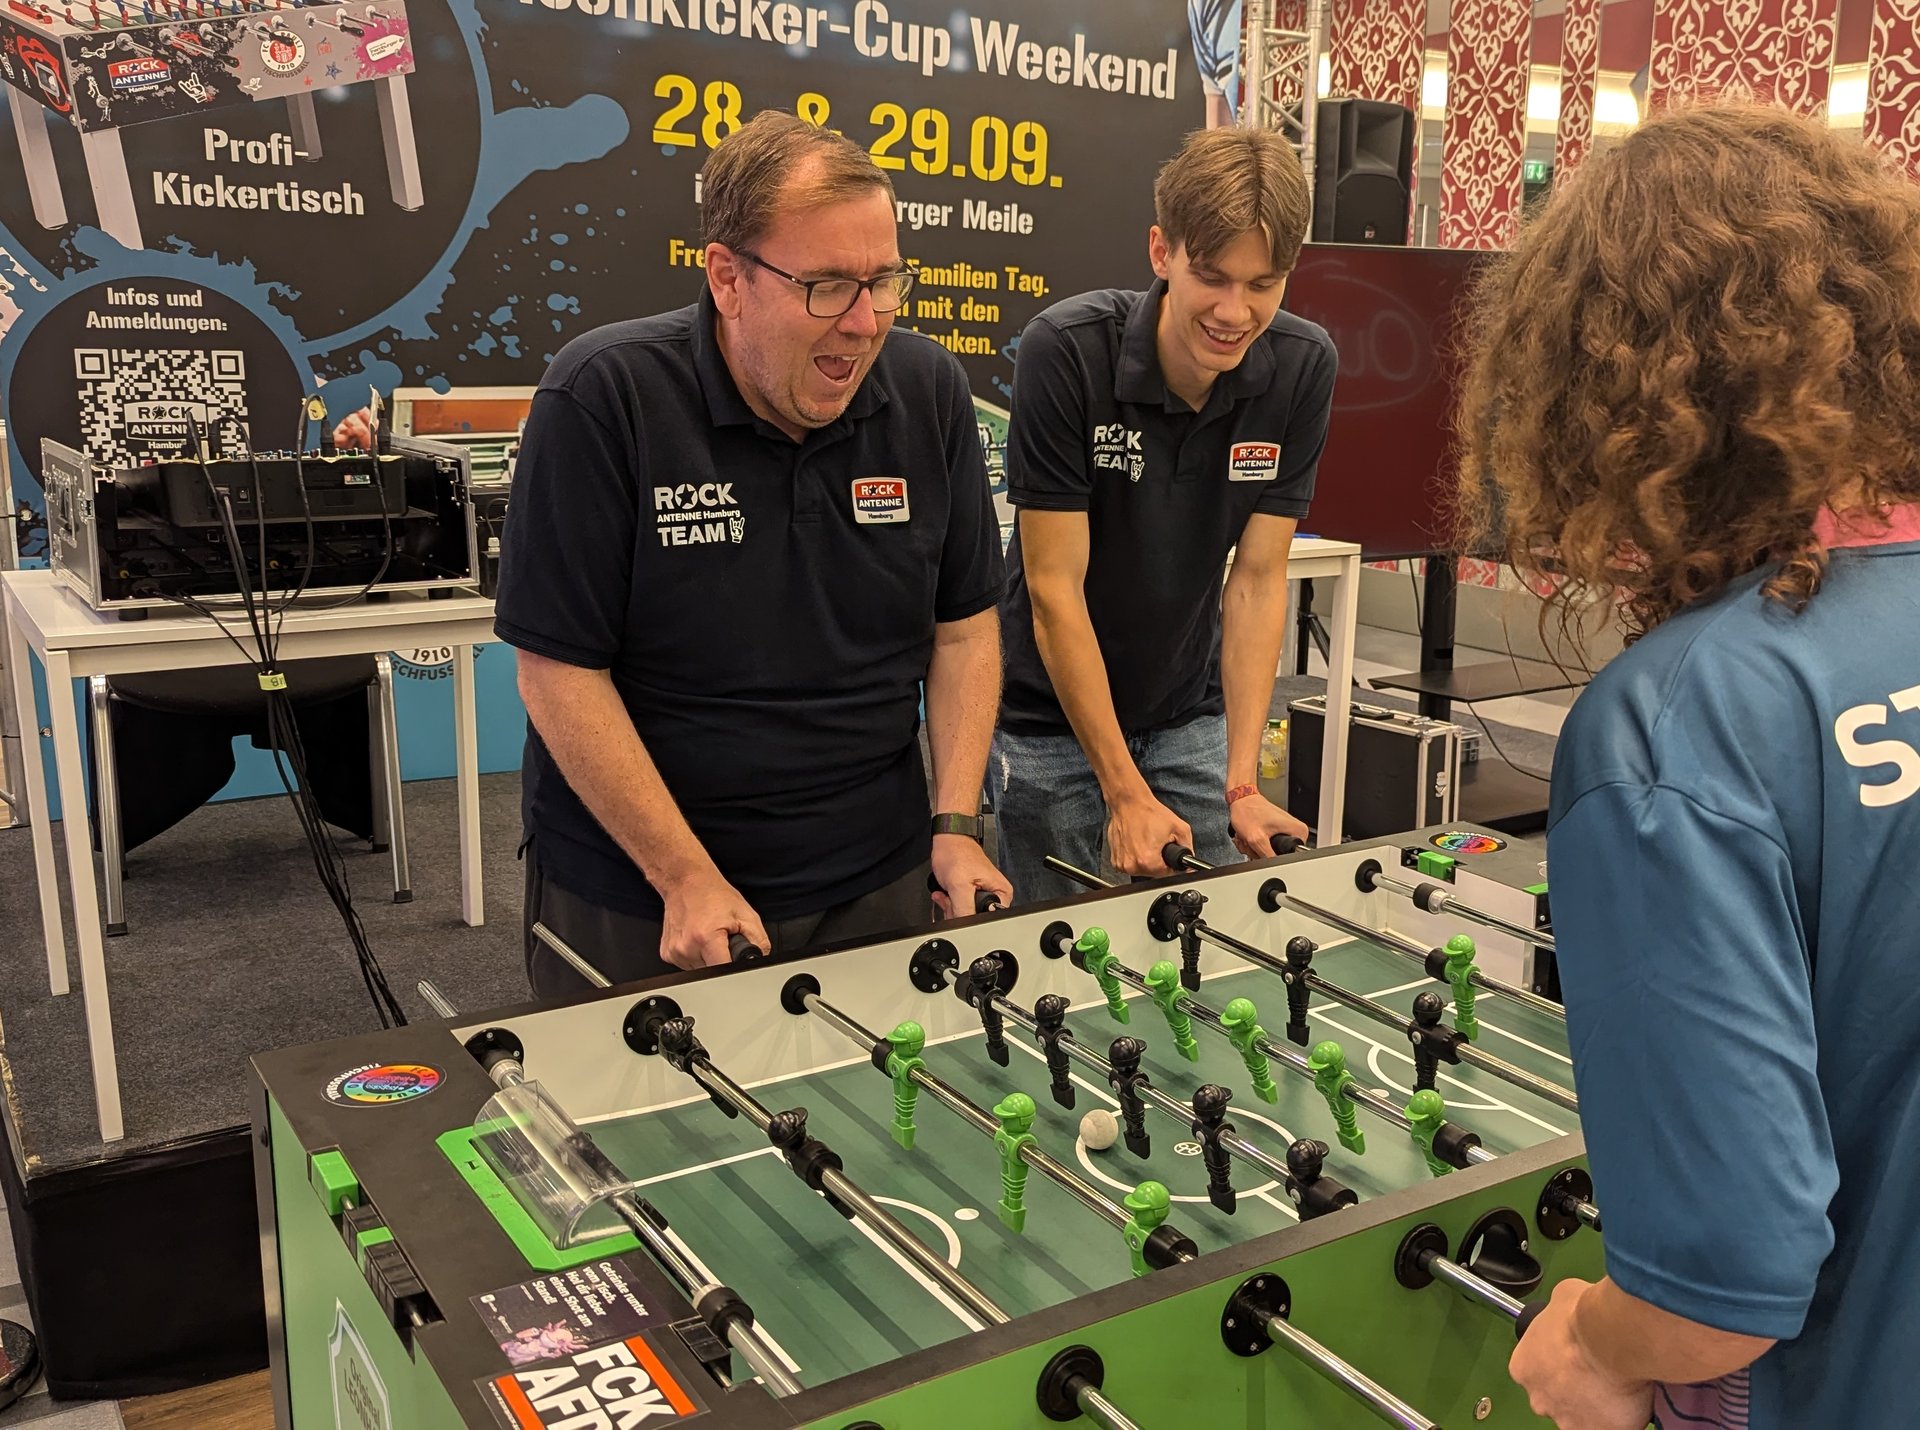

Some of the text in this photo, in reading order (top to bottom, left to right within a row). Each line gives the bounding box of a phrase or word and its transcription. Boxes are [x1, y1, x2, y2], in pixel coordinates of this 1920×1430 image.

[519, 0, 1178, 100] kicker-Cup Weekend
[115, 71, 168, 86] ANTENNE
[118, 60, 160, 74] ROCK
[277, 63, 295, 71] 1910
[128, 84, 159, 94] Hamburg
[204, 128, 309, 166] Profi-
[869, 102, 1063, 189] 29.09.
[153, 171, 365, 215] Kickertisch
[962, 198, 1034, 234] Meile
[669, 239, 705, 269] Fre
[1005, 266, 1049, 298] Tag.
[107, 287, 203, 307] Infos und
[917, 296, 953, 321] mit
[960, 296, 1000, 323] den
[86, 310, 228, 334] Anmeldungen:
[138, 405, 193, 420] ROCK
[148, 441, 183, 450] Hambur
[1094, 423, 1142, 450] ROK
[1234, 459, 1274, 468] ANTENNE
[1239, 447, 1271, 458] ROCK
[1242, 471, 1264, 479] Hamburg
[654, 482, 738, 510] ROCK
[861, 484, 896, 496] ROCK
[858, 498, 902, 508] ANTENNE
[657, 508, 741, 523] ANTENNE Hamburg
[868, 512, 894, 520] Hamburg
[658, 522, 726, 547] TEAM
[412, 646, 451, 662] 1910
[532, 1280, 558, 1305] Stand!
[565, 1271, 585, 1286] Hol
[583, 1293, 607, 1317] lieber
[582, 1266, 619, 1304] vom Tisch.
[598, 1261, 649, 1317] Getränke runter
[549, 1276, 593, 1327] einen Shot am
[571, 1341, 677, 1430] FCK
